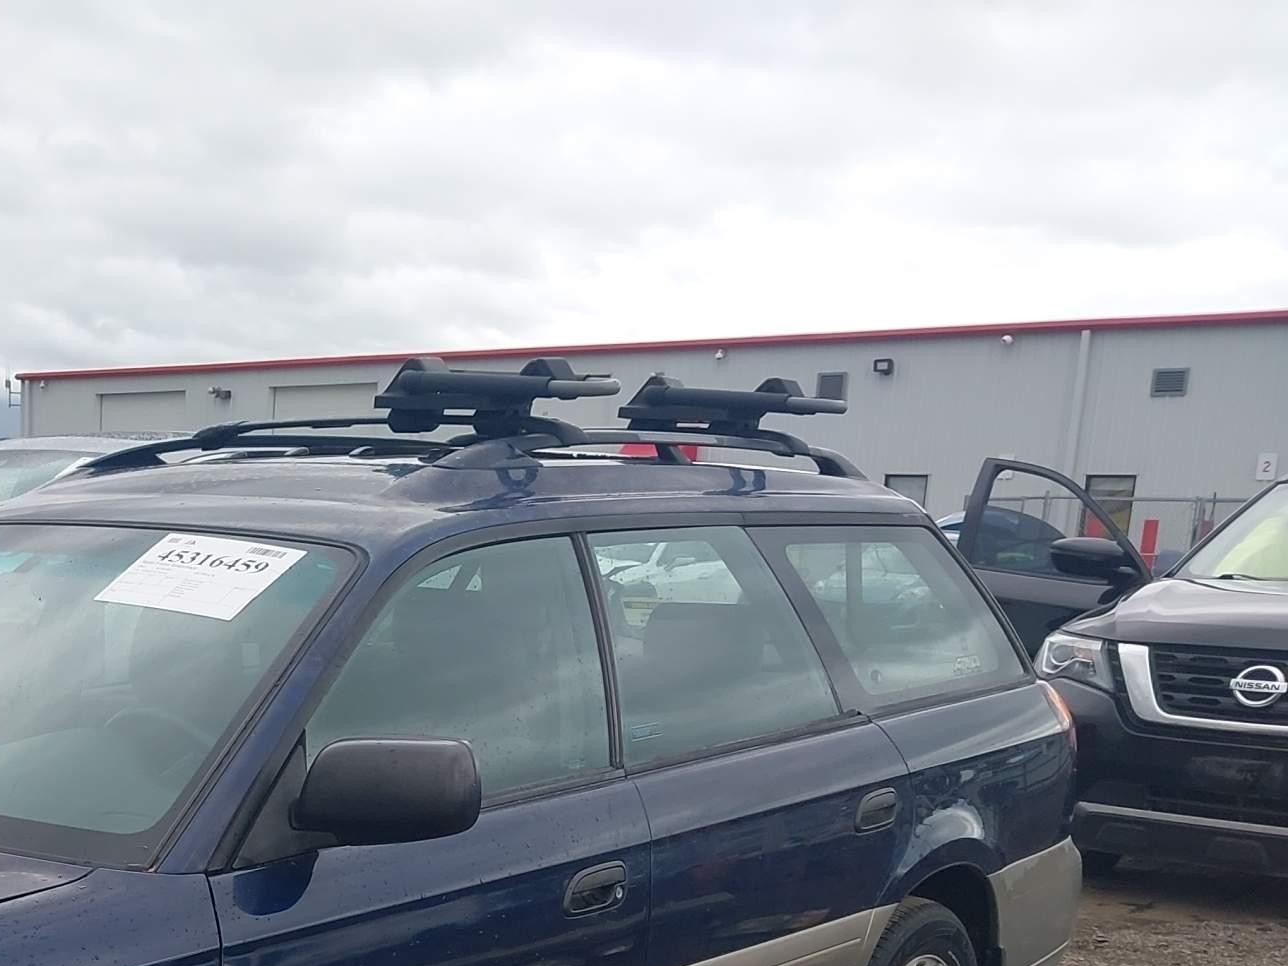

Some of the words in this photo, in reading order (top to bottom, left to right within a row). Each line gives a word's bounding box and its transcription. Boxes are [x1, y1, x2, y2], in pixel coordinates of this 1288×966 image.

[1262, 460, 1272, 473] 2
[158, 549, 269, 575] 45316459
[1234, 681, 1281, 691] NISSAN
